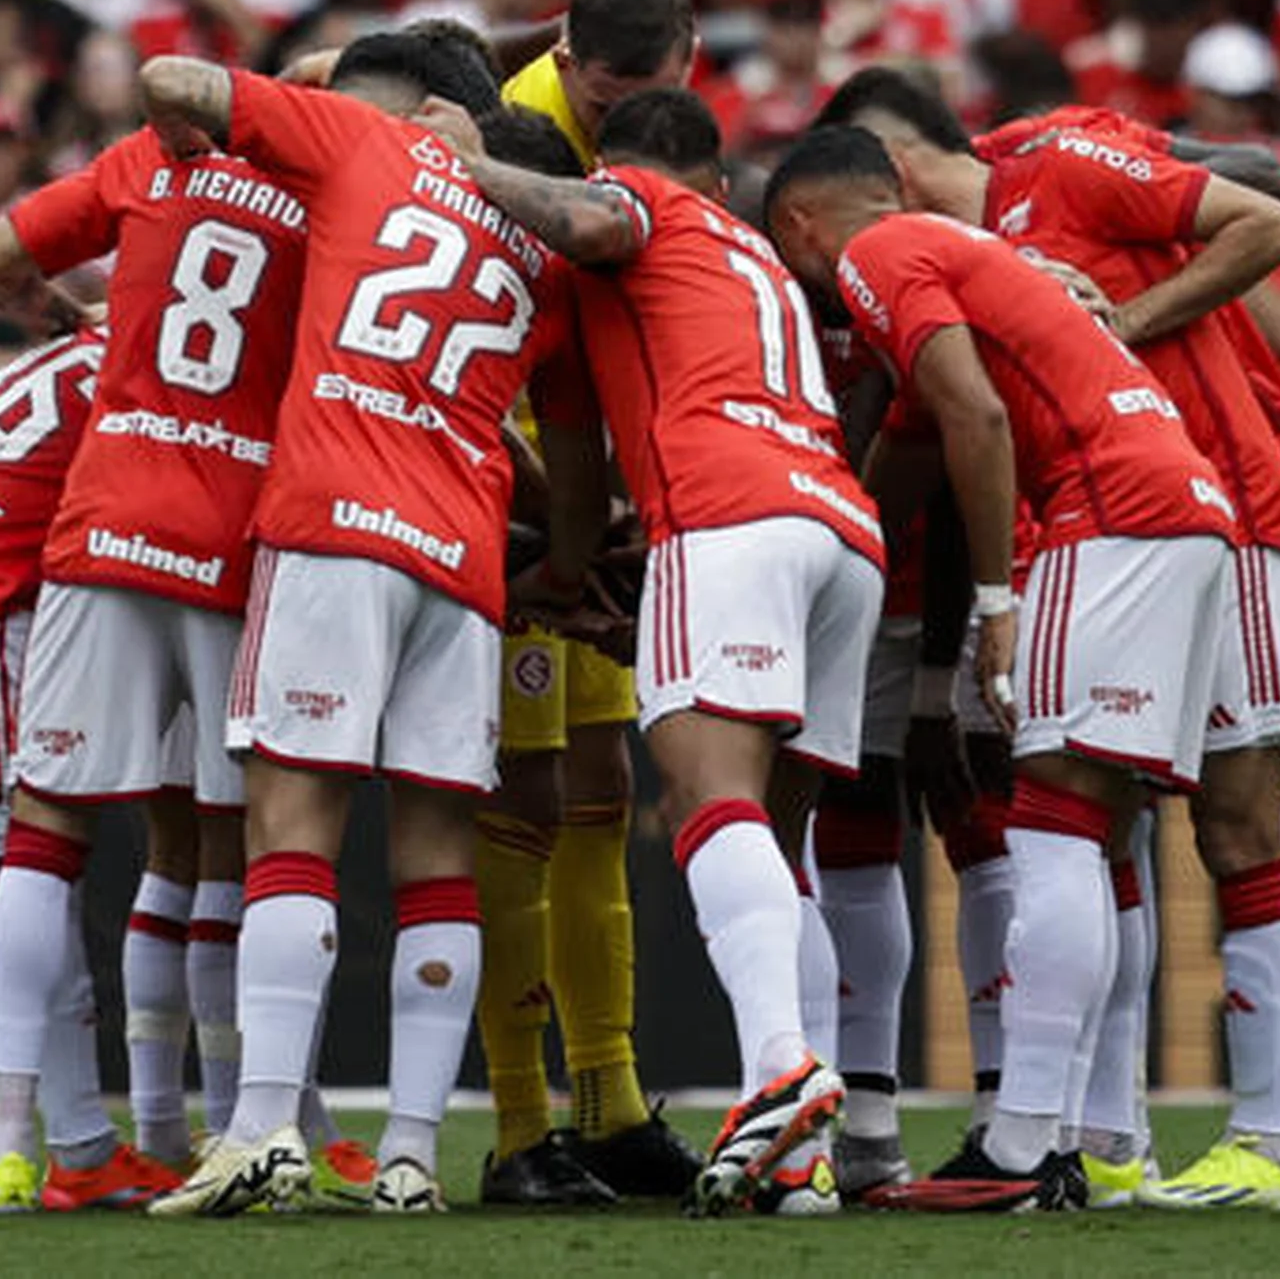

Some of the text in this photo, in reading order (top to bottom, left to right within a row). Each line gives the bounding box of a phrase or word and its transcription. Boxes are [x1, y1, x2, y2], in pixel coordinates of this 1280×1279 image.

[157, 219, 269, 394] 8
[87, 527, 225, 587] Unimed
[332, 498, 467, 571] Unimed
